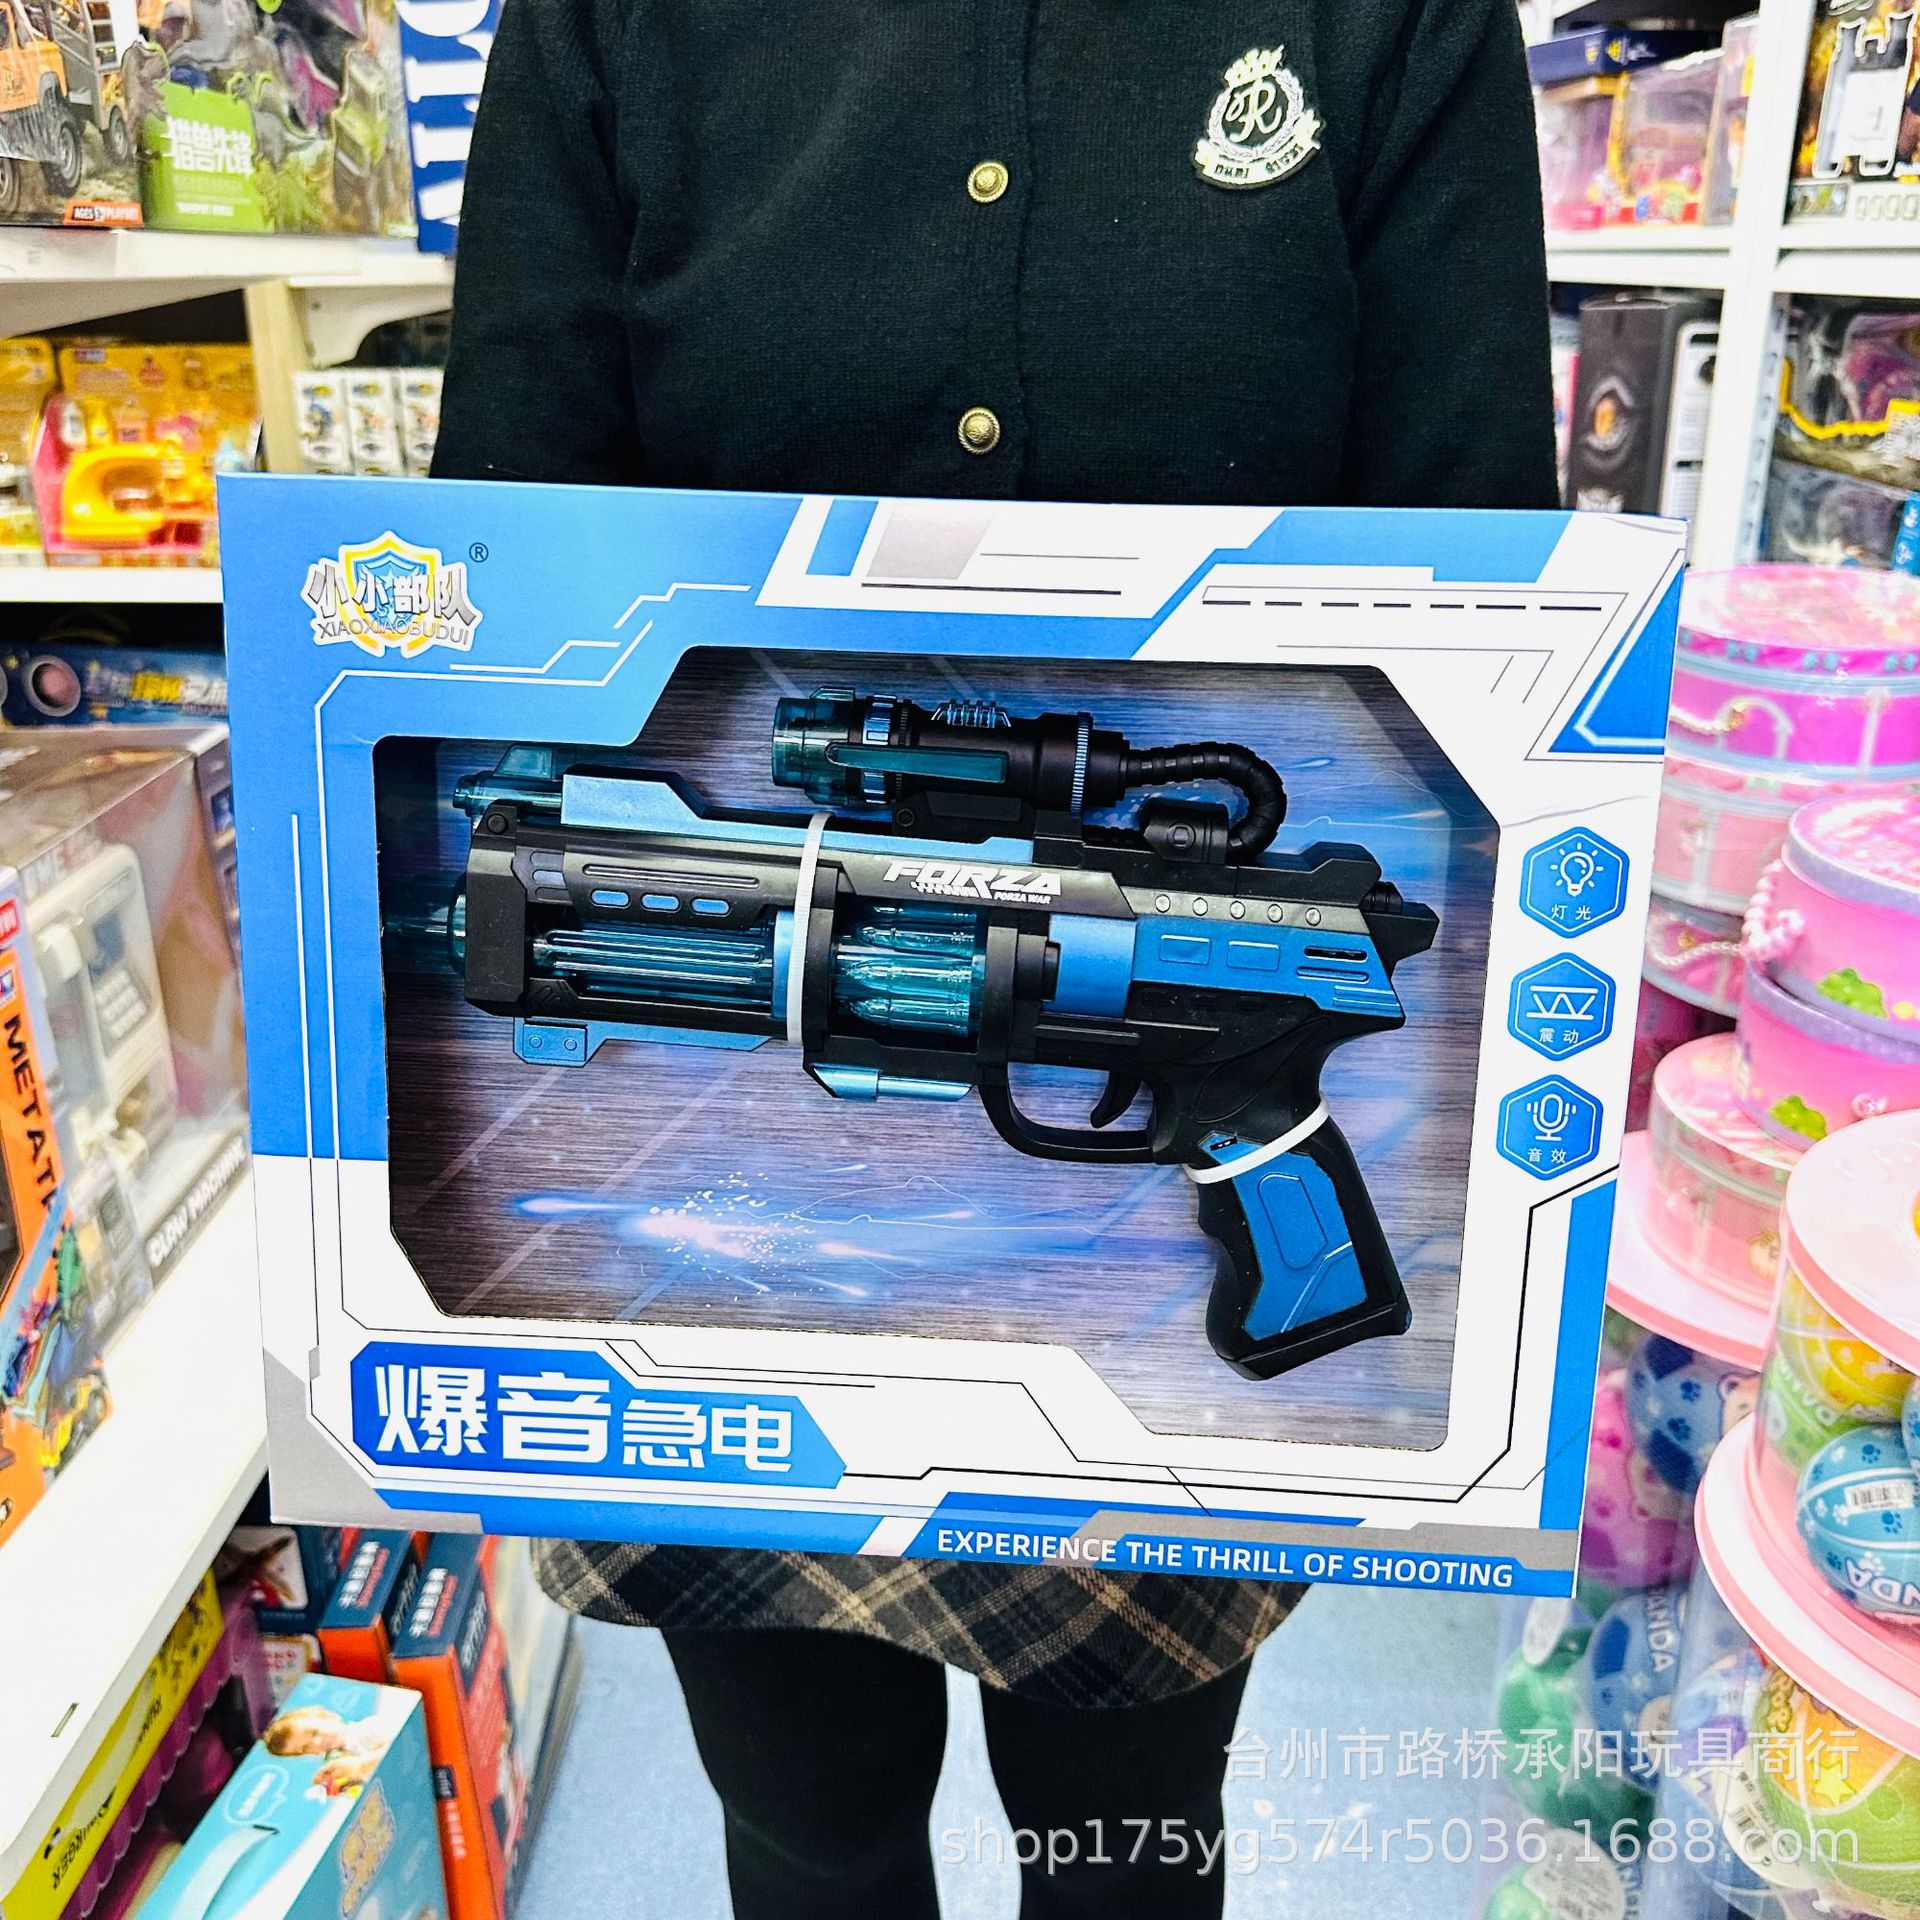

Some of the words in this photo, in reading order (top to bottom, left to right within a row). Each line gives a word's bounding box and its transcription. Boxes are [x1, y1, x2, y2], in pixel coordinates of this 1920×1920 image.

[307, 564, 477, 626] 小小部队
[317, 617, 470, 646] XIAOXIAOBUDUI
[883, 861, 1062, 899] FORZA
[994, 891, 1029, 903] FORZA
[1551, 904, 1592, 921] 灯光
[1539, 1027, 1579, 1044] 震动
[1527, 1147, 1567, 1164] 音效
[375, 1363, 795, 1473] 爆音急电
[937, 1528, 1117, 1564] EXPERIENCE
[1124, 1541, 1183, 1568] THE
[1191, 1545, 1294, 1575] THRILL
[1303, 1553, 1345, 1577] OF
[1351, 1556, 1514, 1589] SHOOTING
